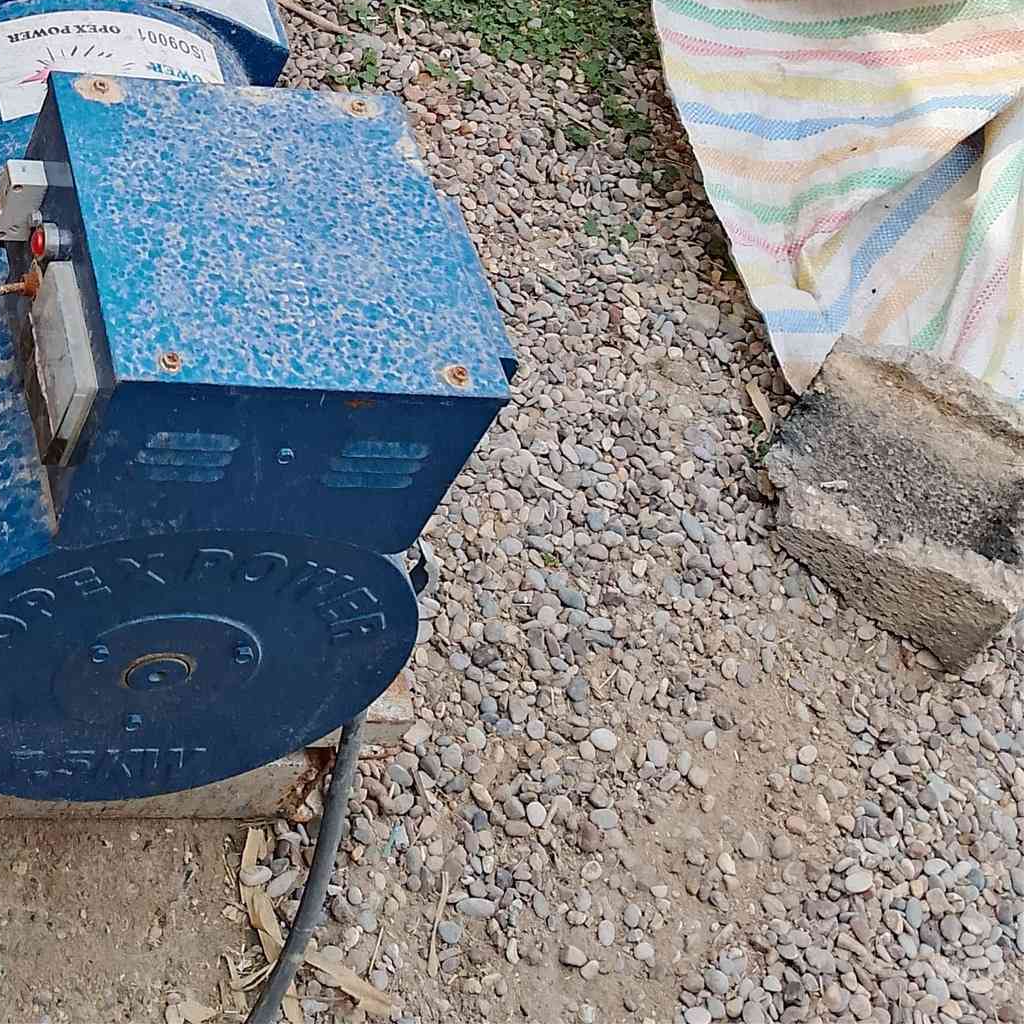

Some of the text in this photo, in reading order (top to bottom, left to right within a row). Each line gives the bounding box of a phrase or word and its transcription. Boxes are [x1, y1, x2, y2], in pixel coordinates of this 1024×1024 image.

[7, 23, 122, 44] OPEX POWER
[136, 27, 207, 63] ISO9001
[187, 546, 388, 640] POWER
